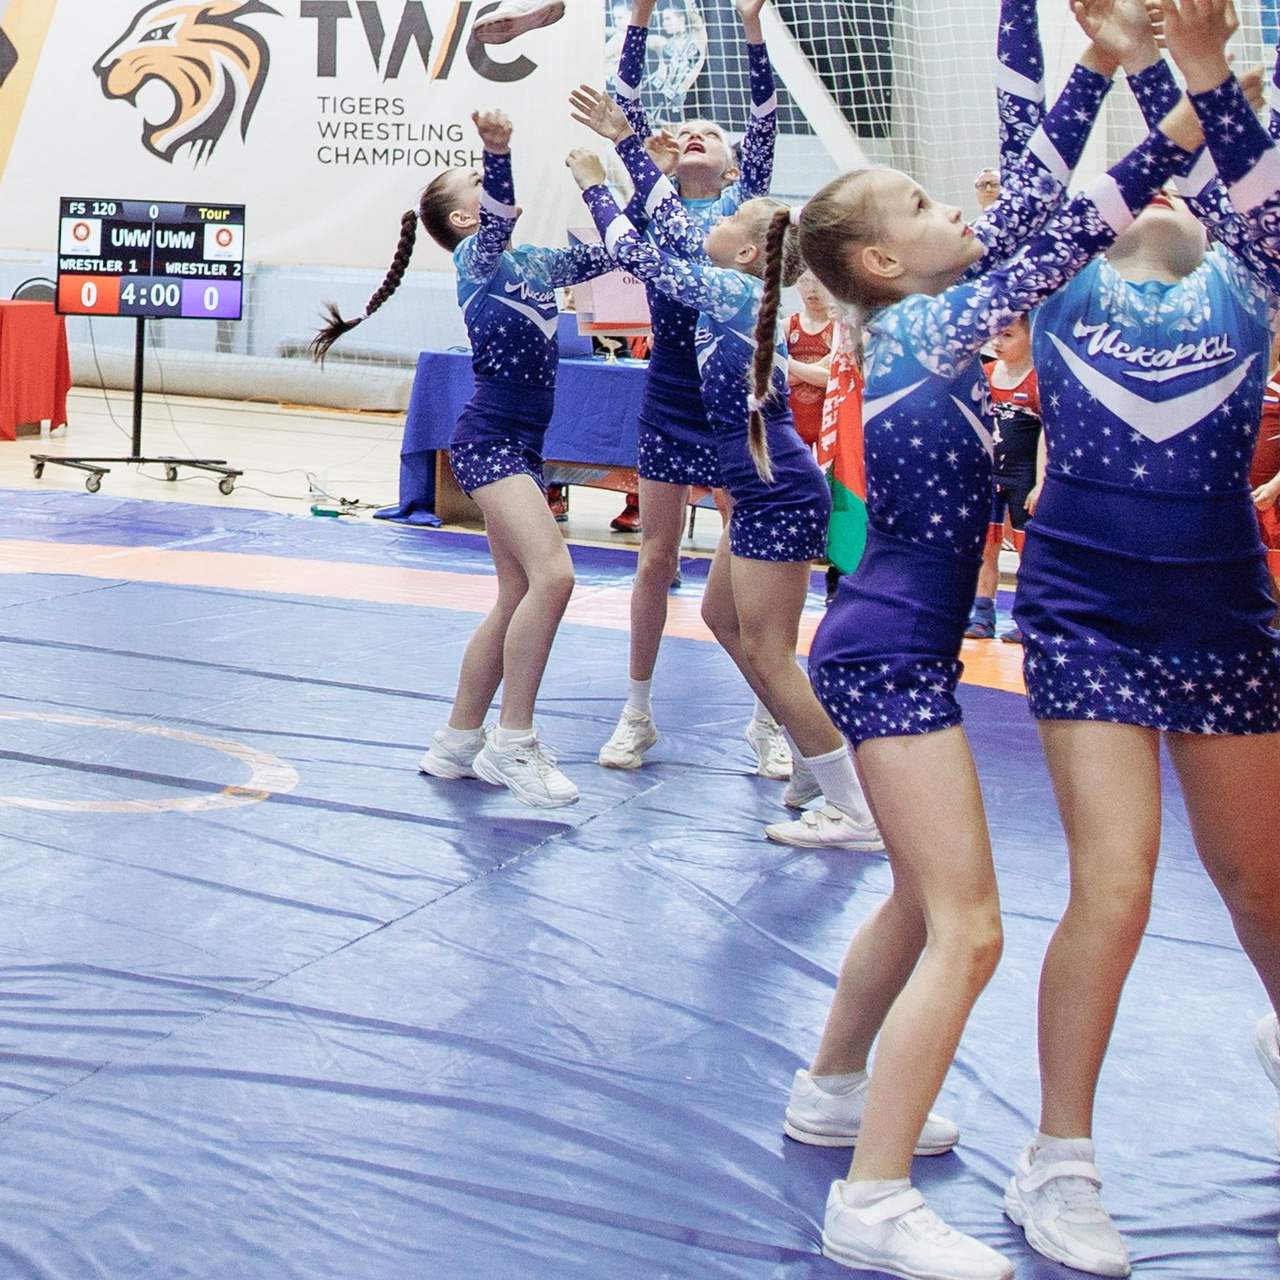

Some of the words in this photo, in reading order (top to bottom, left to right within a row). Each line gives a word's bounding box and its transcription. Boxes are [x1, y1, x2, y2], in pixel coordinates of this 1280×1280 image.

[317, 96, 405, 116] TIGERS
[317, 121, 464, 142] WRESTLING
[317, 146, 484, 168] CHAMPIONSH
[69, 202, 86, 215] FS
[92, 202, 117, 216] 120
[149, 204, 159, 219] 0
[198, 207, 230, 220] Tour
[111, 228, 151, 248] UWW
[155, 230, 196, 249] UWW
[60, 258, 123, 272] WRESTLER
[128, 260, 138, 272] 1
[165, 262, 227, 276] WRESTLER
[233, 263, 241, 277] 2
[80, 282, 97, 307] 0
[121, 283, 180, 307] 4:00
[203, 286, 219, 311] 0
[1073, 316, 1238, 382] Искорки
